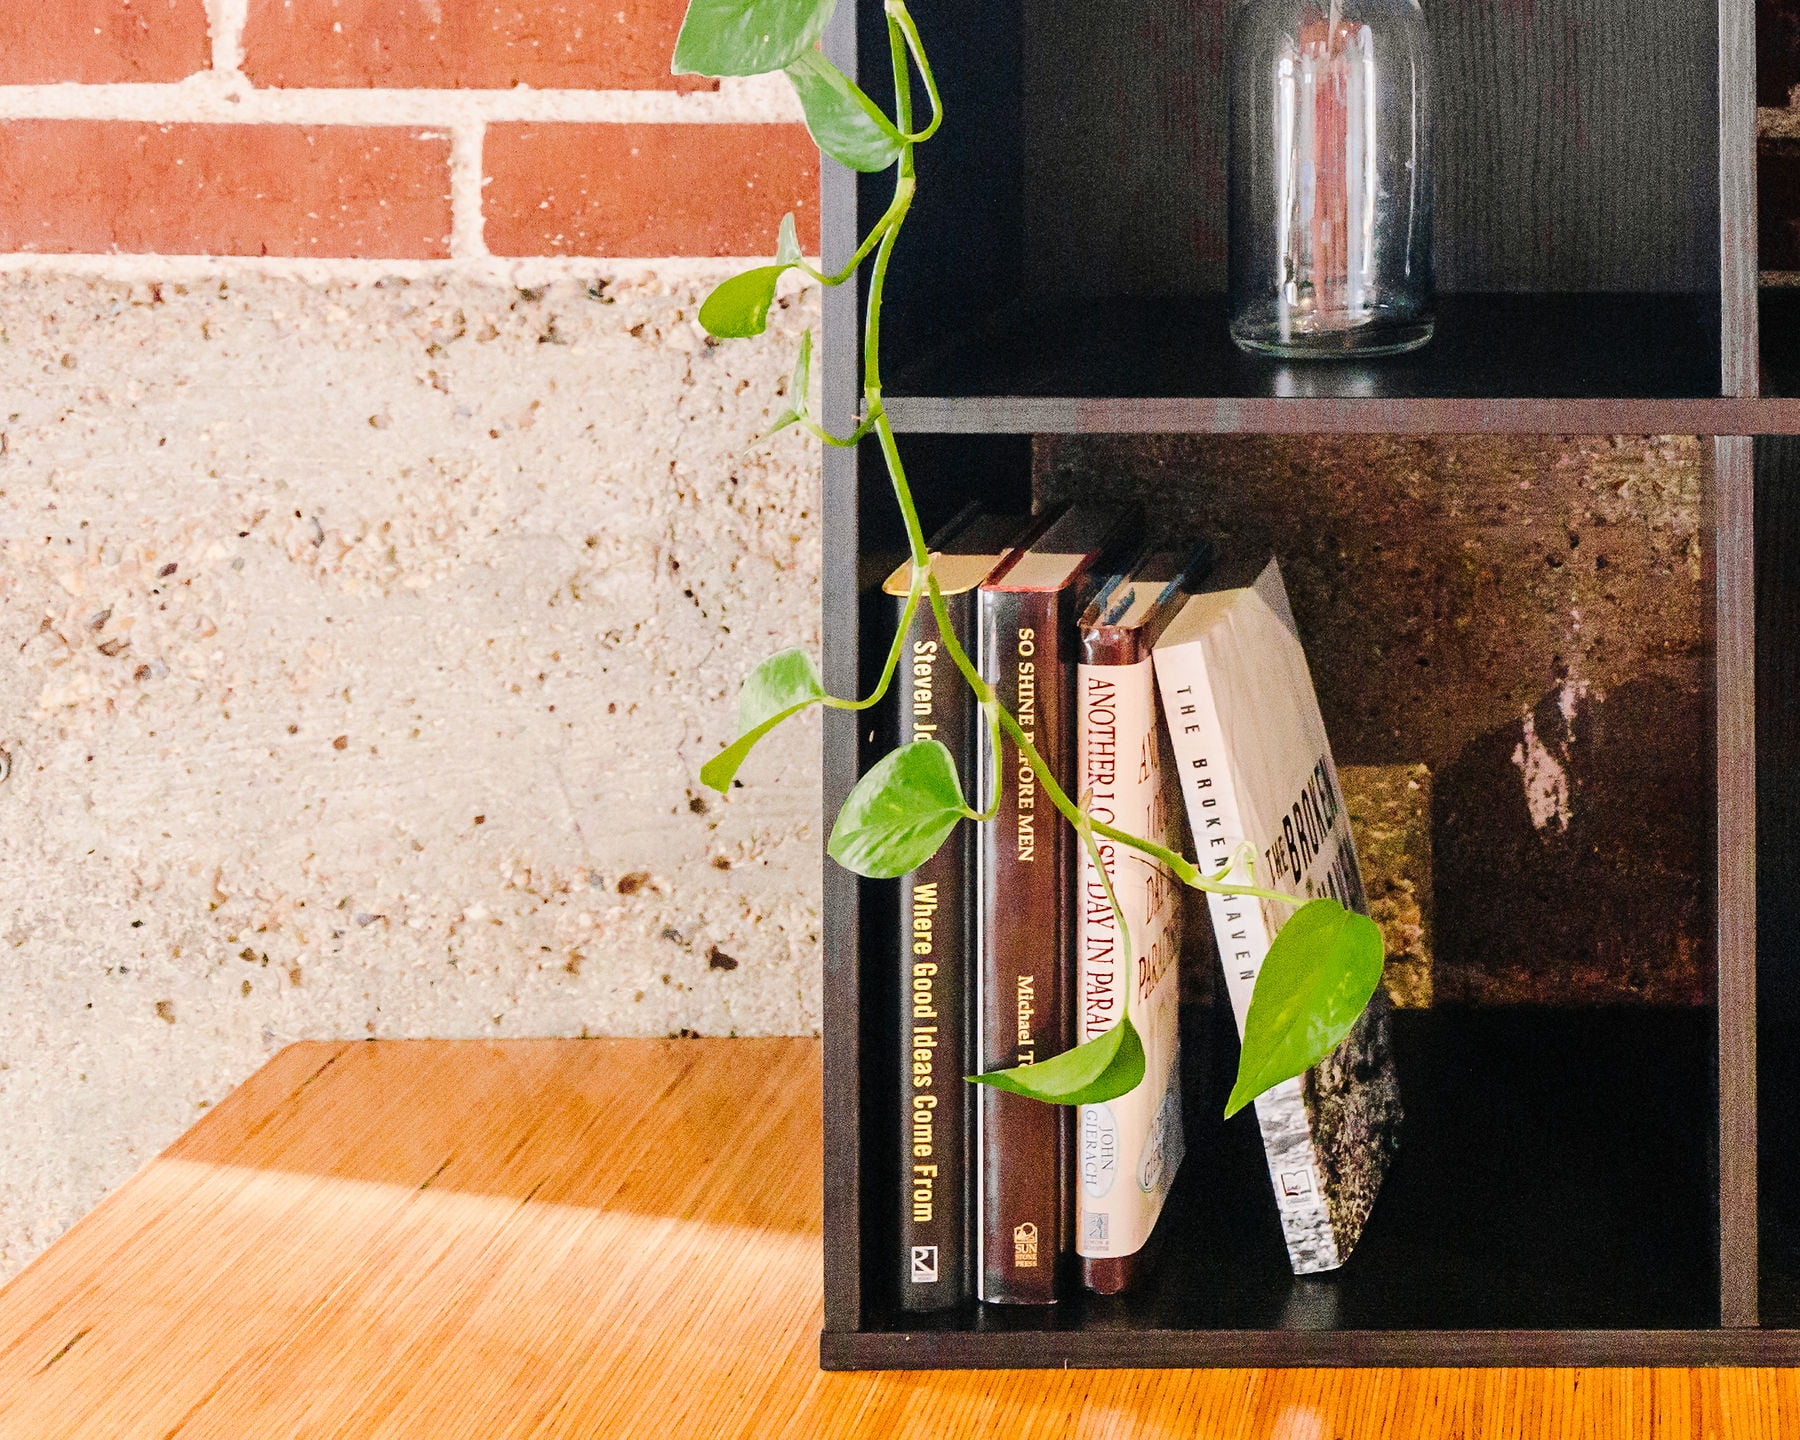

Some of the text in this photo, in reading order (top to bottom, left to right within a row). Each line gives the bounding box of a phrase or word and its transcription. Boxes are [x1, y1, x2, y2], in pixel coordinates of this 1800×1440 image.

[1018, 628, 1035, 657] SO
[913, 640, 938, 716] Steven
[1018, 662, 1035, 726] SHINE
[1088, 677, 1116, 786] ANOTHER
[1018, 815, 1035, 862] MEN
[1177, 685, 1255, 980] THE BROKEN HAVEN
[1265, 835, 1289, 886] THE
[1087, 881, 1114, 929] DAY
[1087, 937, 1114, 964] IN
[1017, 975, 1035, 1046] Michael
[913, 882, 938, 1222] Where Good Ideas Come From
[1086, 1110, 1098, 1185] GIERACH
[1100, 1127, 1114, 1171] JOHN
[1015, 1244, 1037, 1254] SUN
